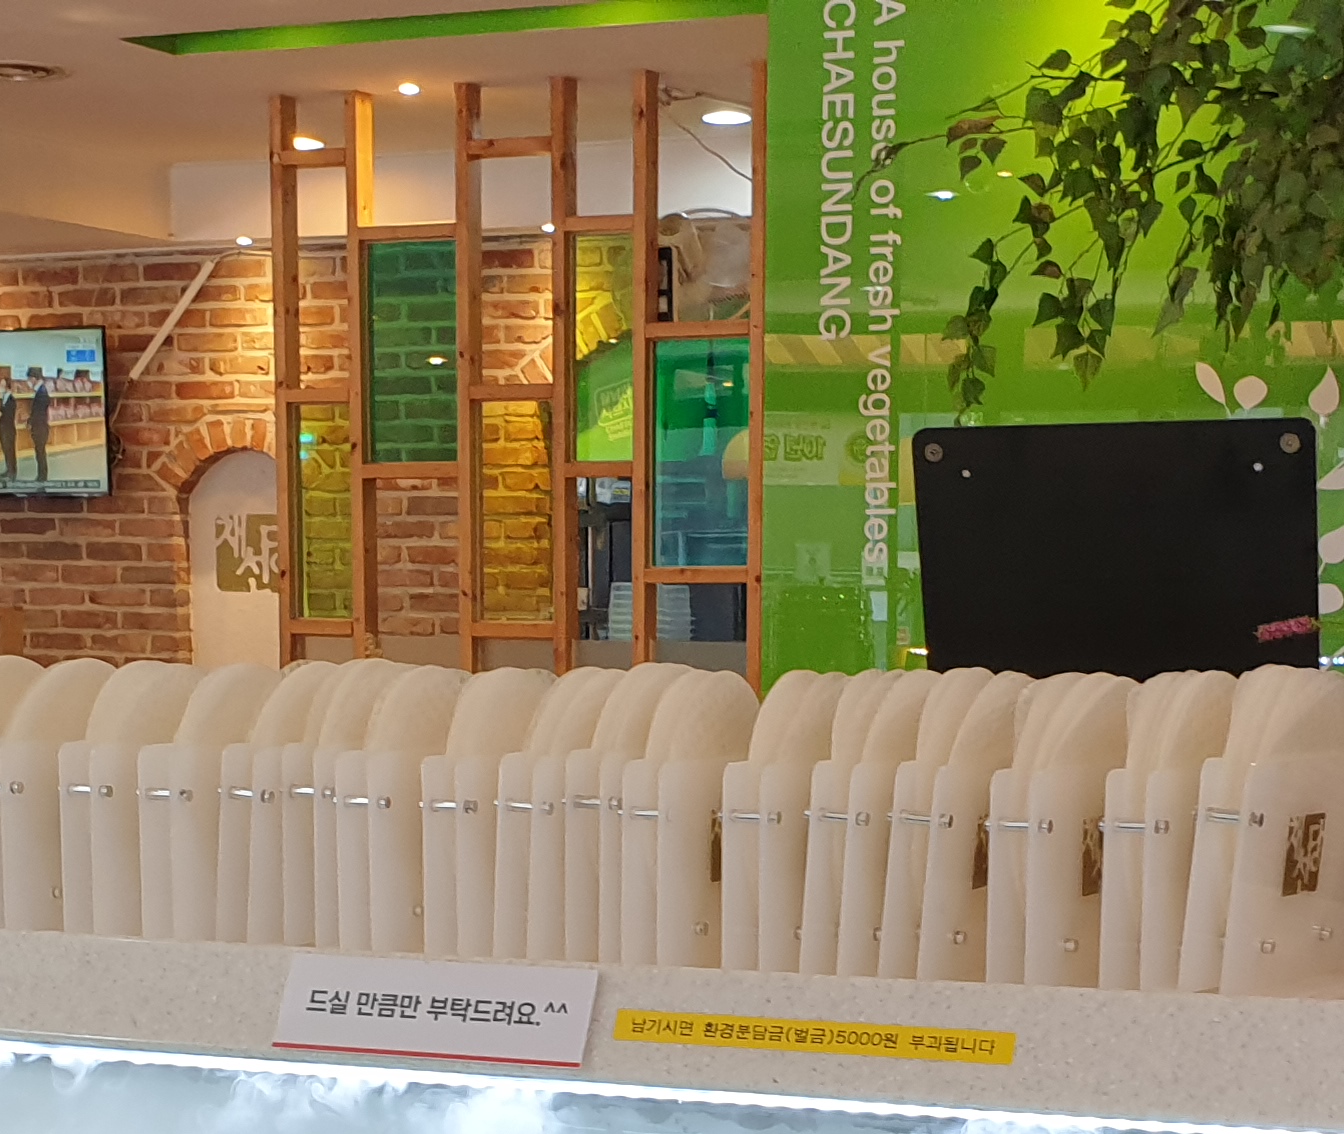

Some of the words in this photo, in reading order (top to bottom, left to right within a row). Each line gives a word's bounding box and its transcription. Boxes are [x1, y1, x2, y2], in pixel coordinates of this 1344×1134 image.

[873, 0, 907, 27] A
[818, 0, 857, 341] CHAESUNDANG
[869, 179, 903, 220] of
[868, 230, 902, 332] fresh
[858, 343, 897, 563] vegetables
[305, 989, 351, 1015] 드실
[356, 991, 423, 1020] 만큼만
[426, 995, 542, 1027] 부탁드려요.
[630, 1018, 695, 1036] 남기시면
[703, 1021, 899, 1050] 환경분담금(벌금)5000원
[908, 1034, 996, 1056] 부과됩니다
